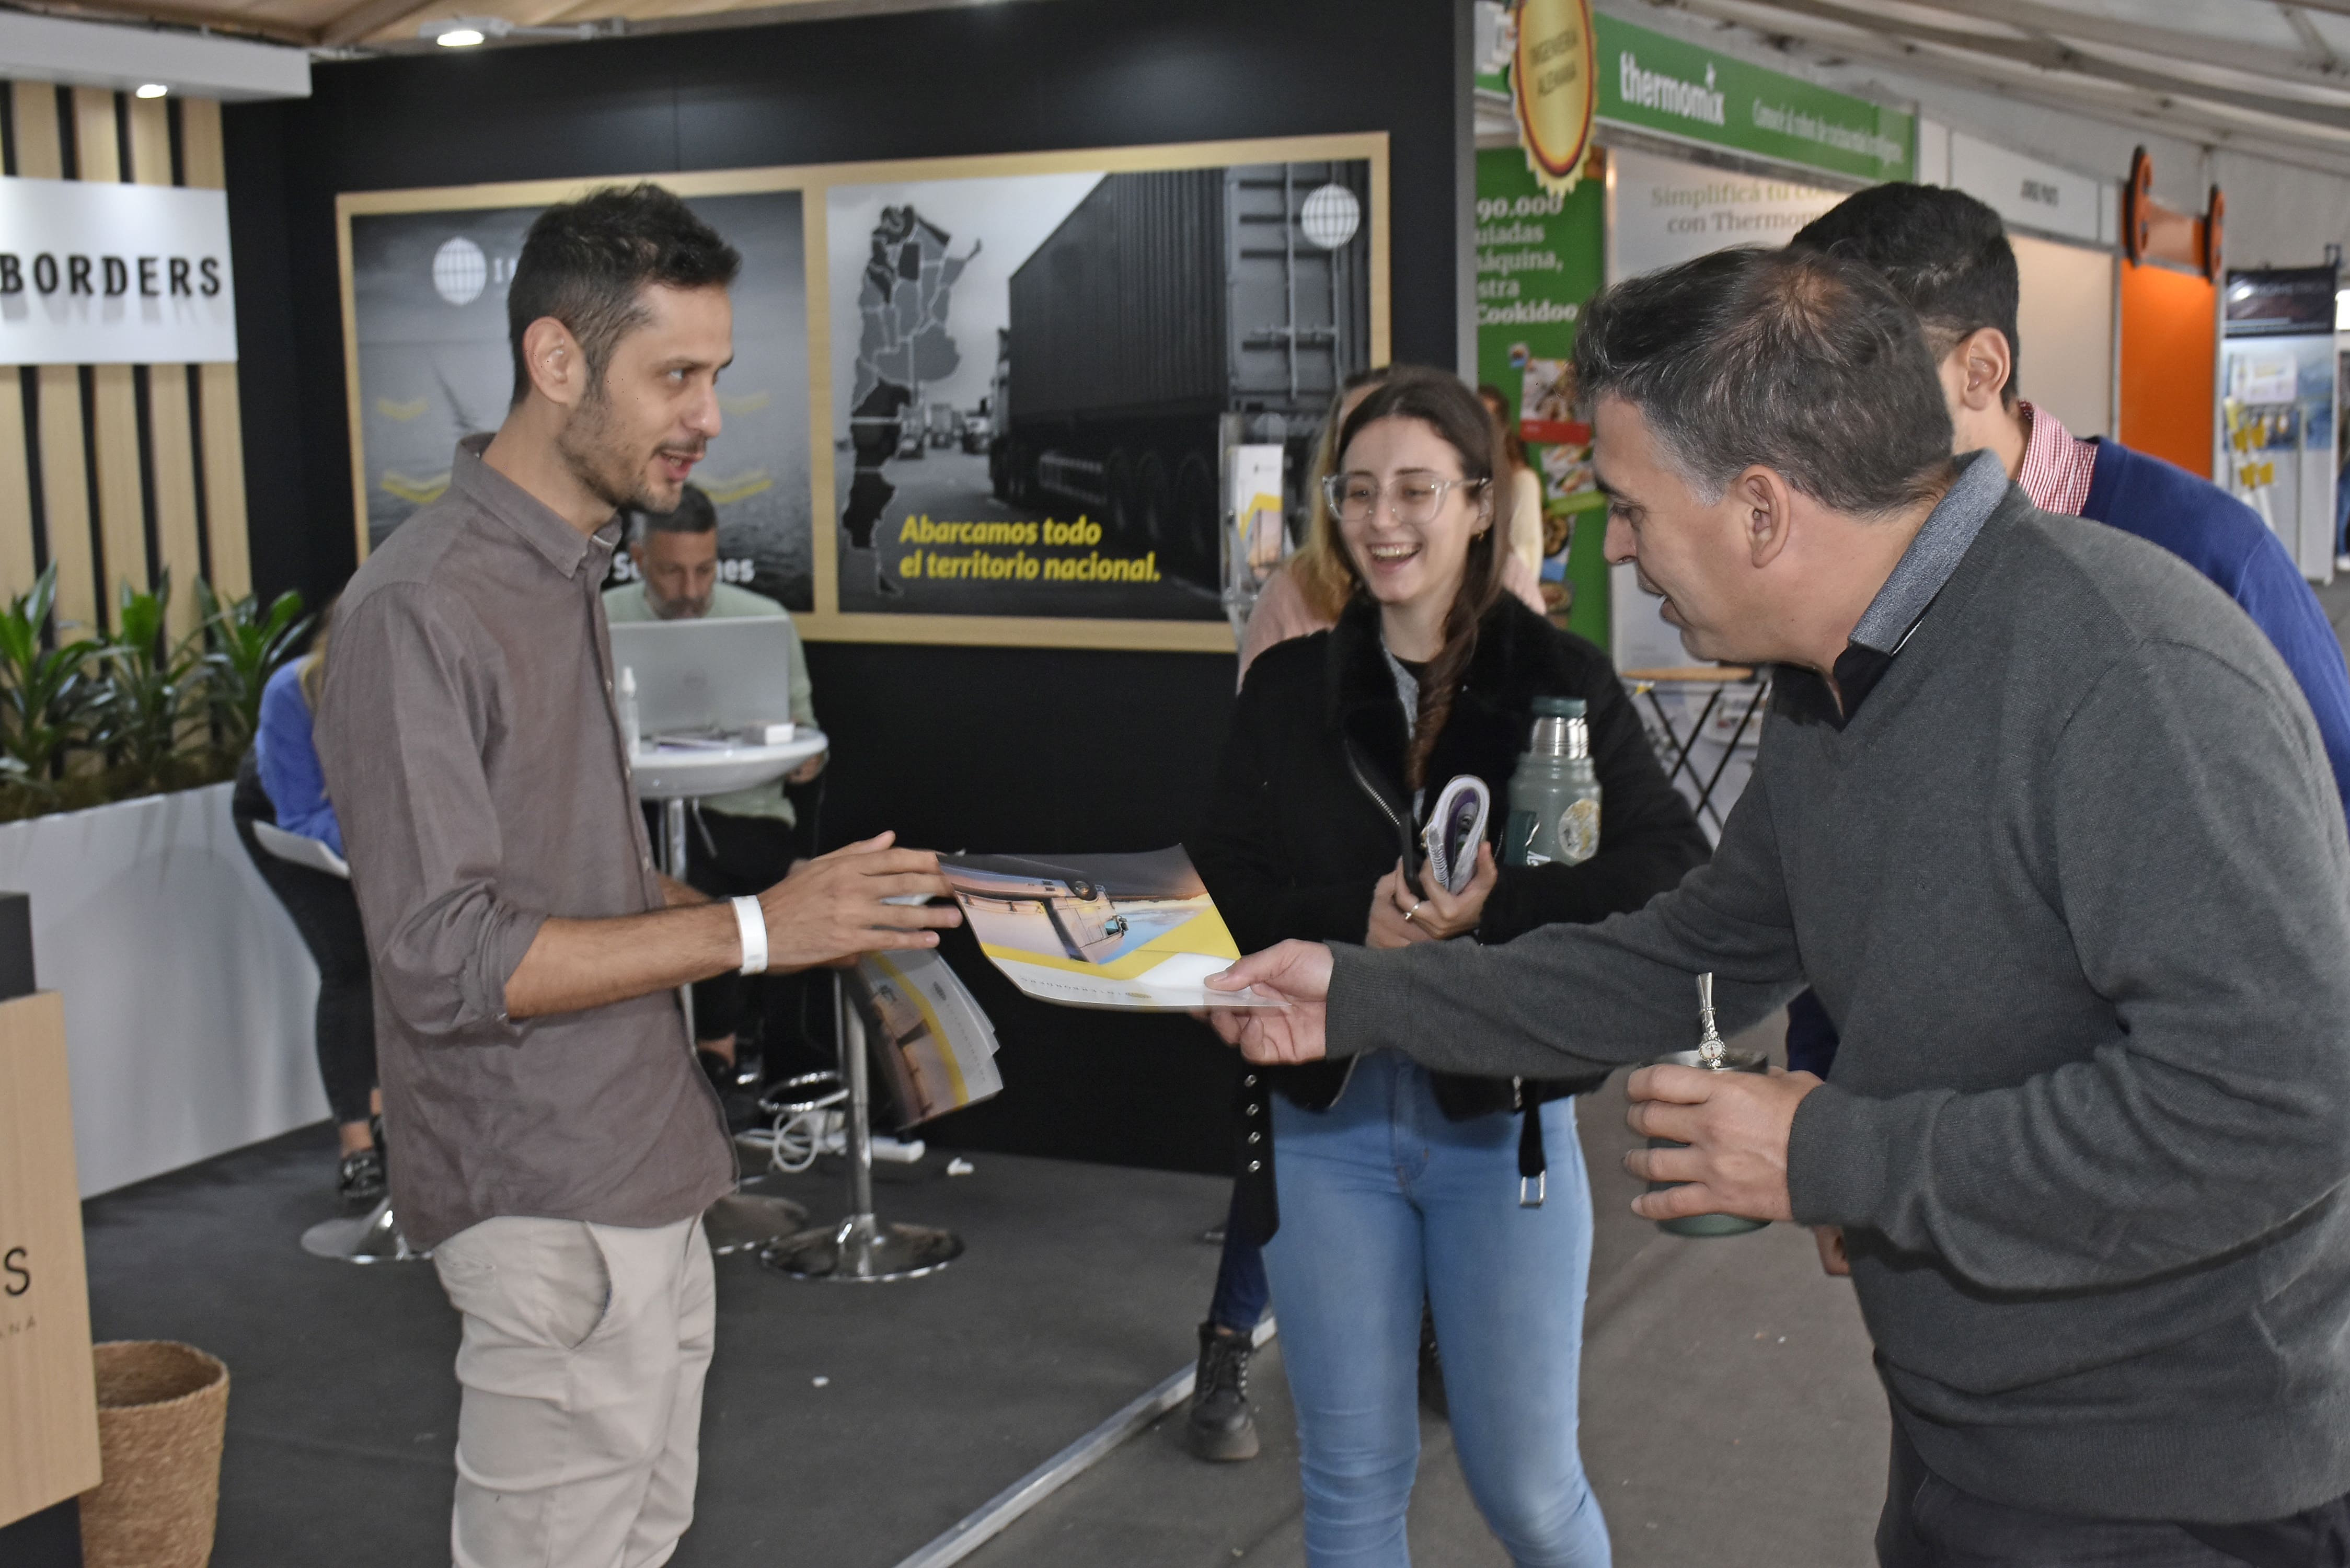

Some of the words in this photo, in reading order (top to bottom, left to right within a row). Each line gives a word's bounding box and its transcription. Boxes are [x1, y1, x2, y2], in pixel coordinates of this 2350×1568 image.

[1621, 51, 1724, 126] thermomix
[1651, 182, 1761, 211] Simplificá
[1667, 215, 1706, 233] con
[0, 253, 221, 297] BORDERS
[898, 514, 1039, 544] Abarcamos
[1043, 514, 1102, 546] todo
[899, 548, 923, 579] el
[927, 549, 1040, 580] territorio
[1043, 550, 1161, 582] nacional.
